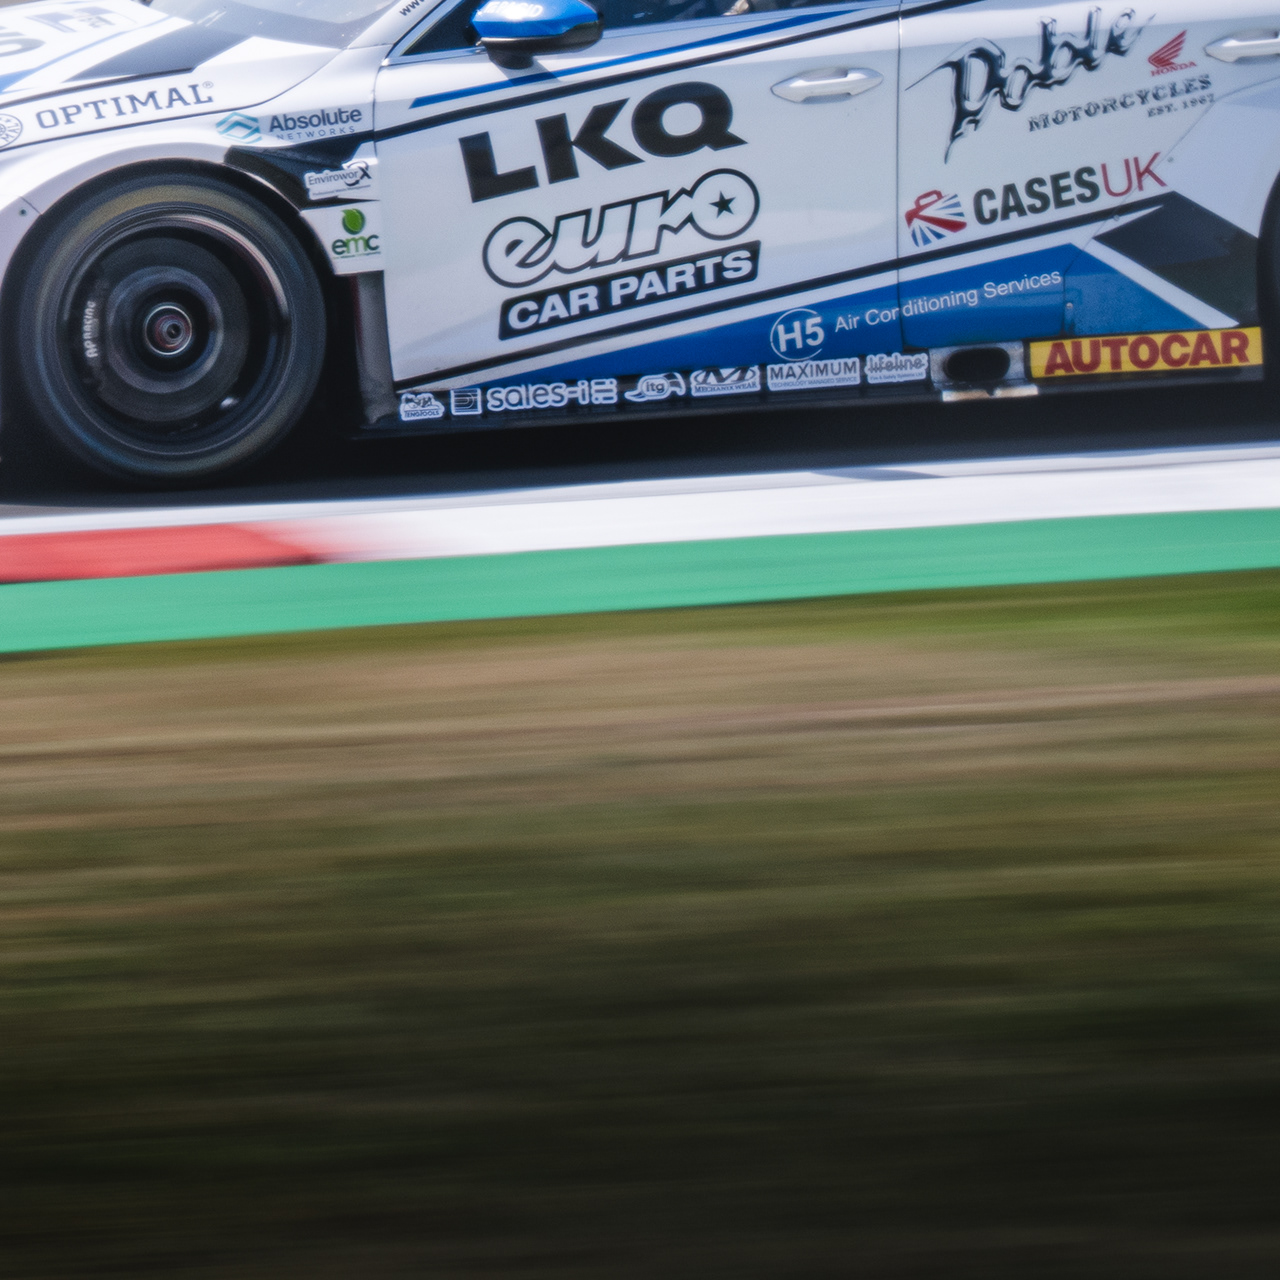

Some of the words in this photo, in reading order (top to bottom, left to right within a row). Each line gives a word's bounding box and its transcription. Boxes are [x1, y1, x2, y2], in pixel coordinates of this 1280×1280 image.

[35, 83, 214, 129] OPTIMAL
[269, 108, 363, 133] Absolute
[1028, 74, 1213, 132] MOTORCYCLES
[276, 126, 356, 141] NETWORKS
[458, 81, 748, 203] LKQ
[332, 234, 380, 256] emc
[483, 168, 760, 288] euro
[508, 284, 599, 330] CAR
[611, 250, 753, 306] PARTS
[777, 317, 825, 352] H5
[835, 314, 859, 332] Air
[983, 271, 1062, 298] Services
[770, 360, 858, 381] MAXIMUM
[1044, 330, 1250, 377] AUTOCAR
[645, 381, 665, 393] itg
